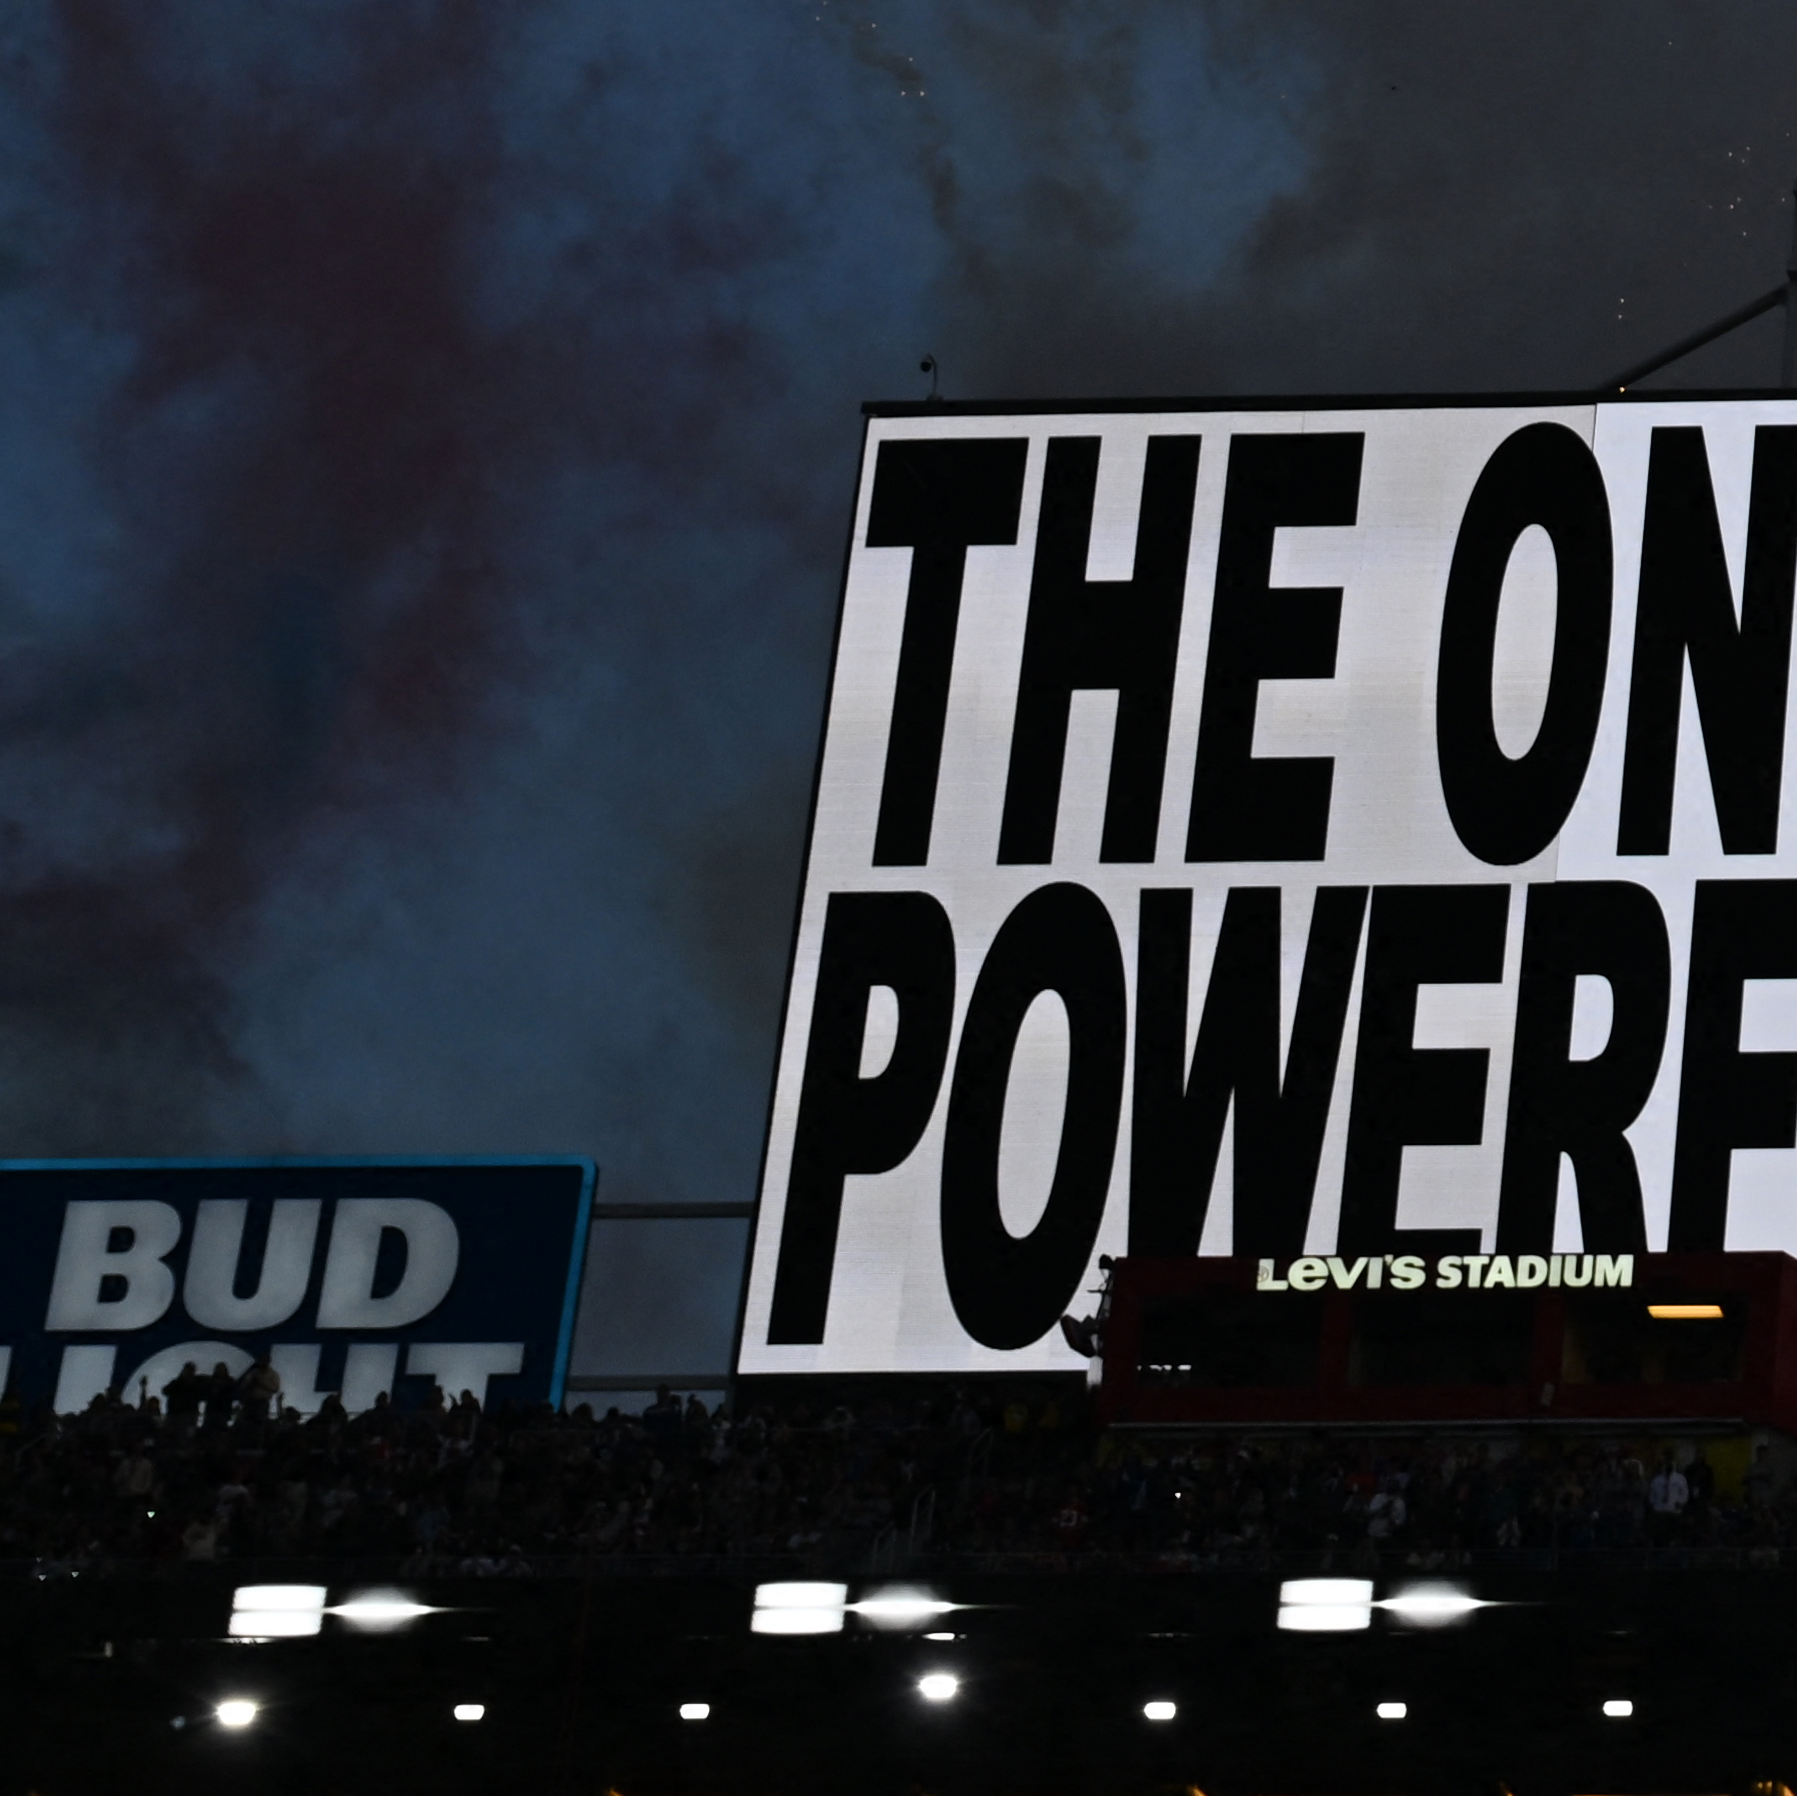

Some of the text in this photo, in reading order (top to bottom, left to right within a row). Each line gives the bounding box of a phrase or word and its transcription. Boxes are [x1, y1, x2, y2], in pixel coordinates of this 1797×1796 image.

[864, 431, 1366, 868] THE
[45, 1198, 460, 1331] BUD
[1435, 1254, 1635, 1289] STADIUM
